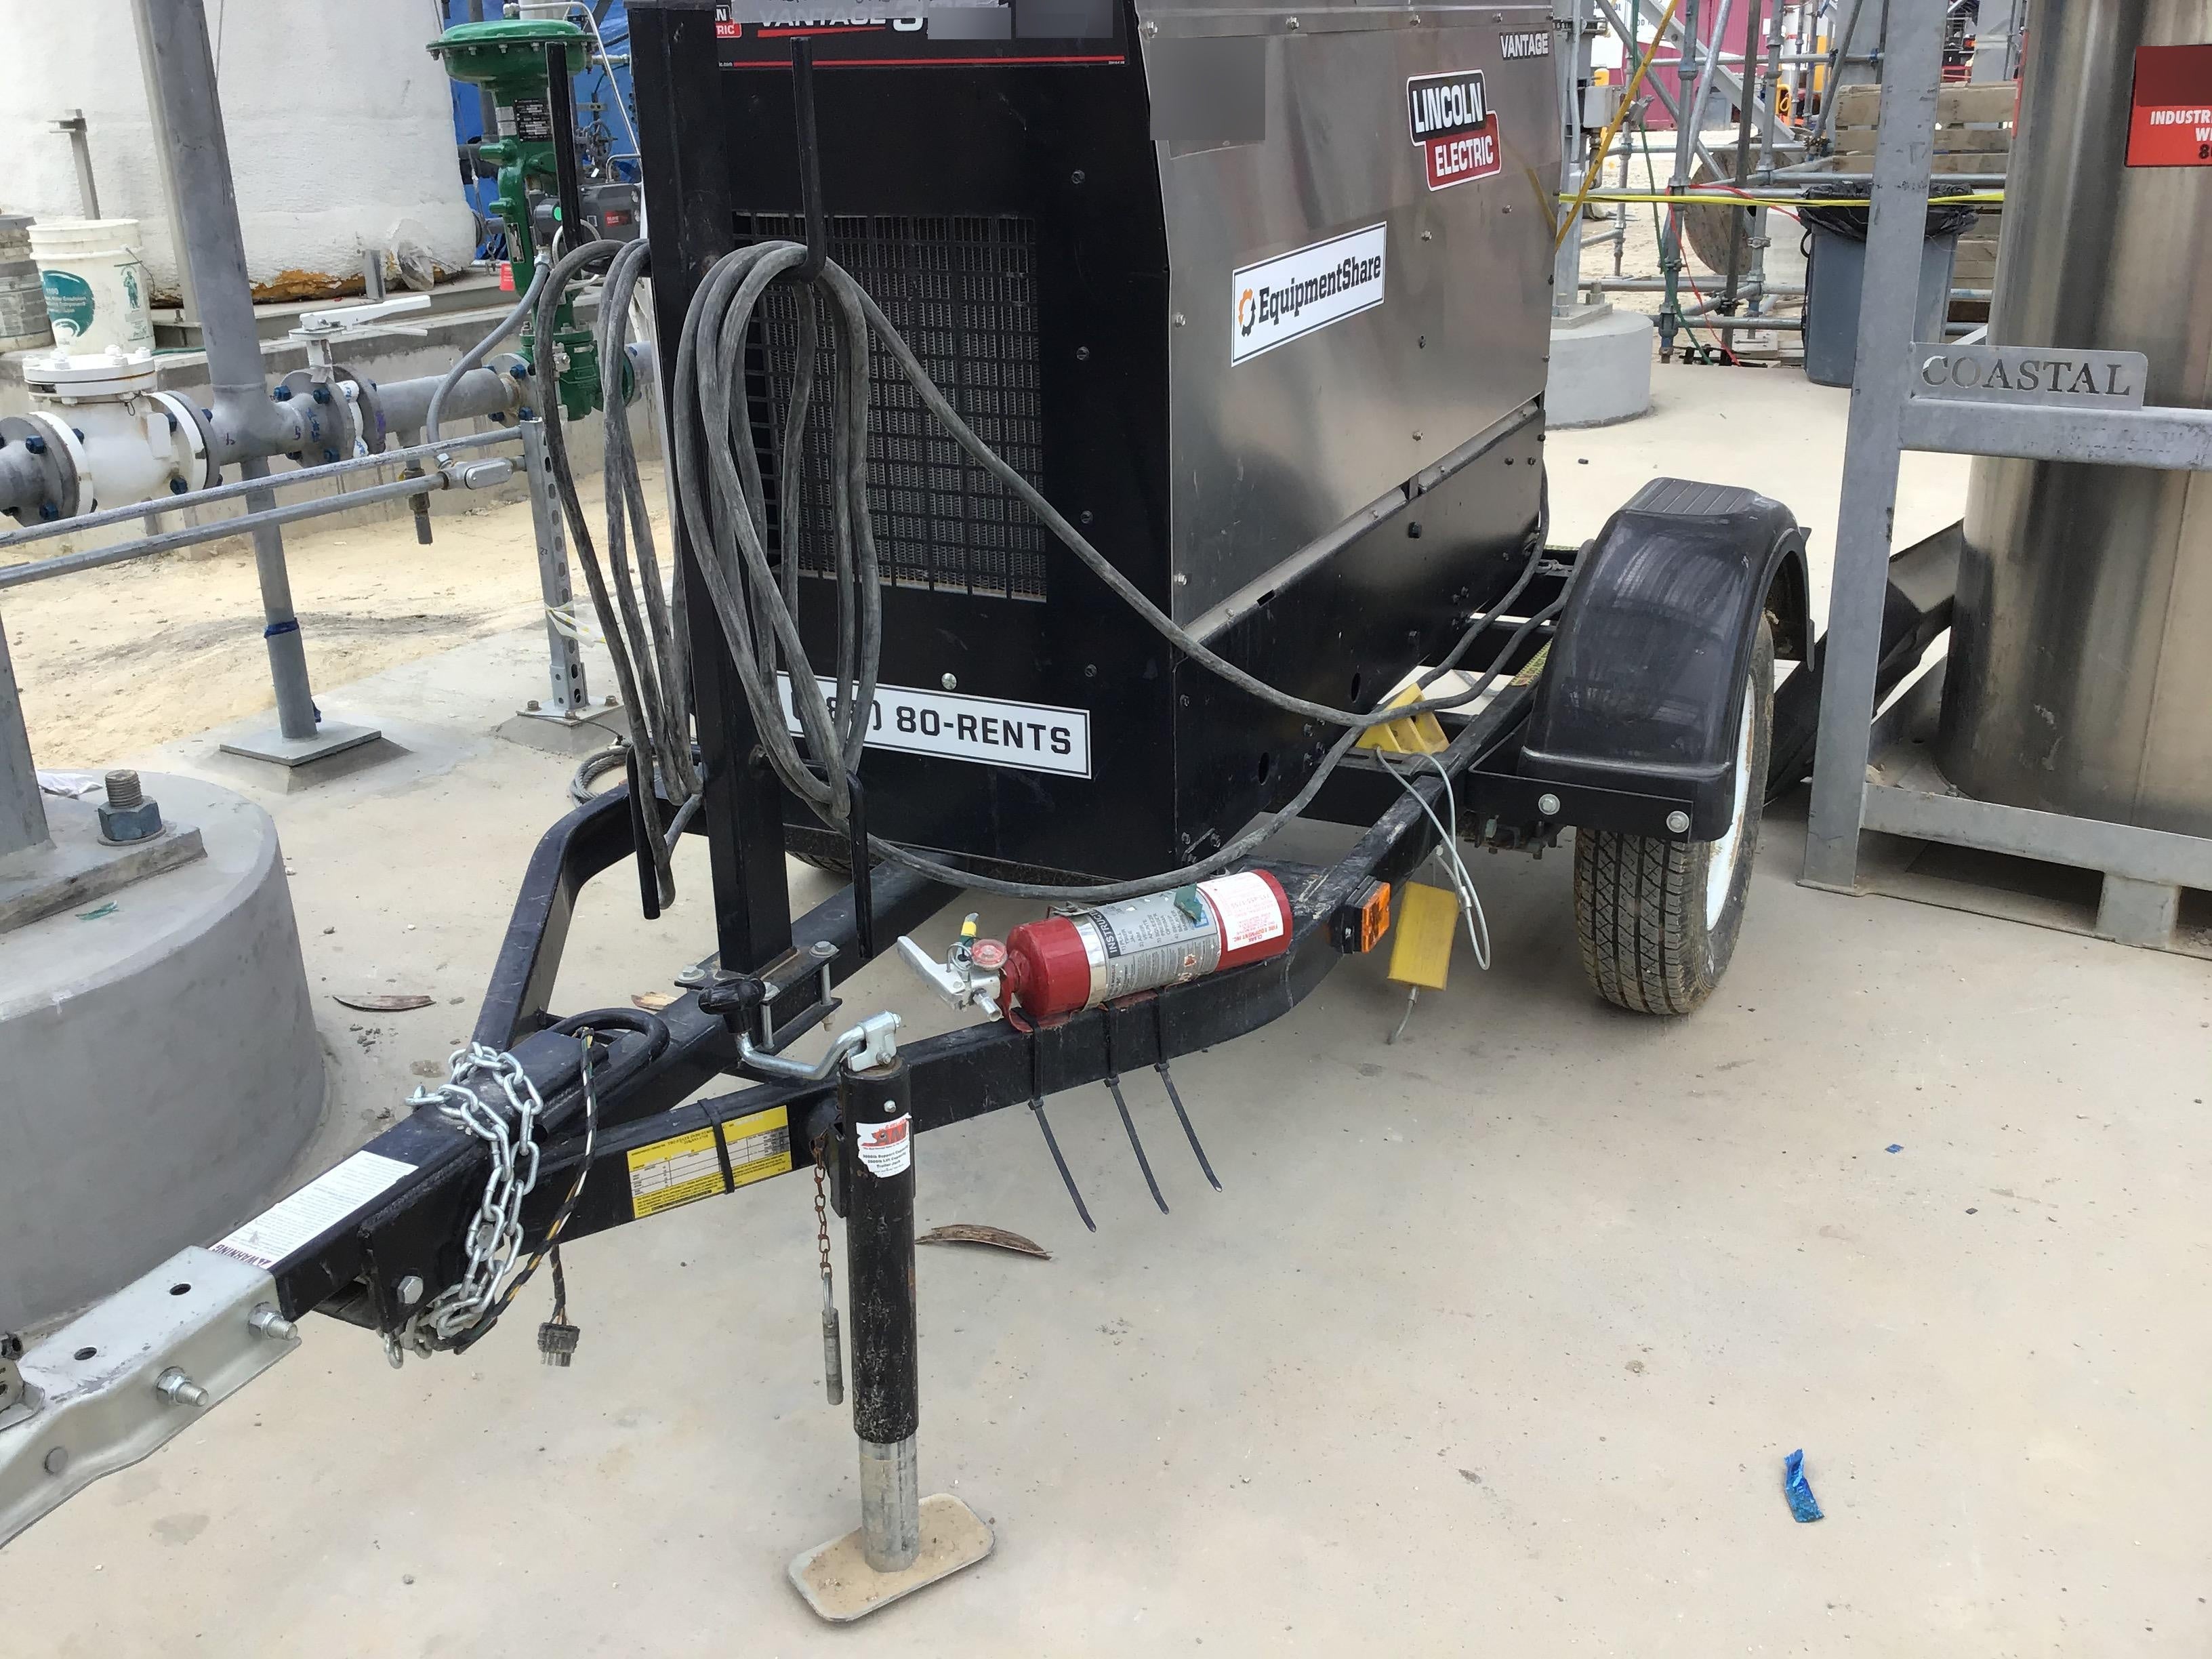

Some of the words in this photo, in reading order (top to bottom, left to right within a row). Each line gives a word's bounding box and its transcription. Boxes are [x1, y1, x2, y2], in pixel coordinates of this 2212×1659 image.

[1500, 33, 1549, 59] VANTAGE
[1412, 82, 1484, 134] LINCOLN
[2150, 109, 2212, 125] INDUSTR
[1434, 136, 1494, 178] ELECTRIC
[1258, 255, 1381, 325] EquipmentShare
[1921, 354, 2131, 396] COASTAL
[896, 705, 1071, 756] 80-RENTS
[212, 1244, 260, 1265] WARNING
